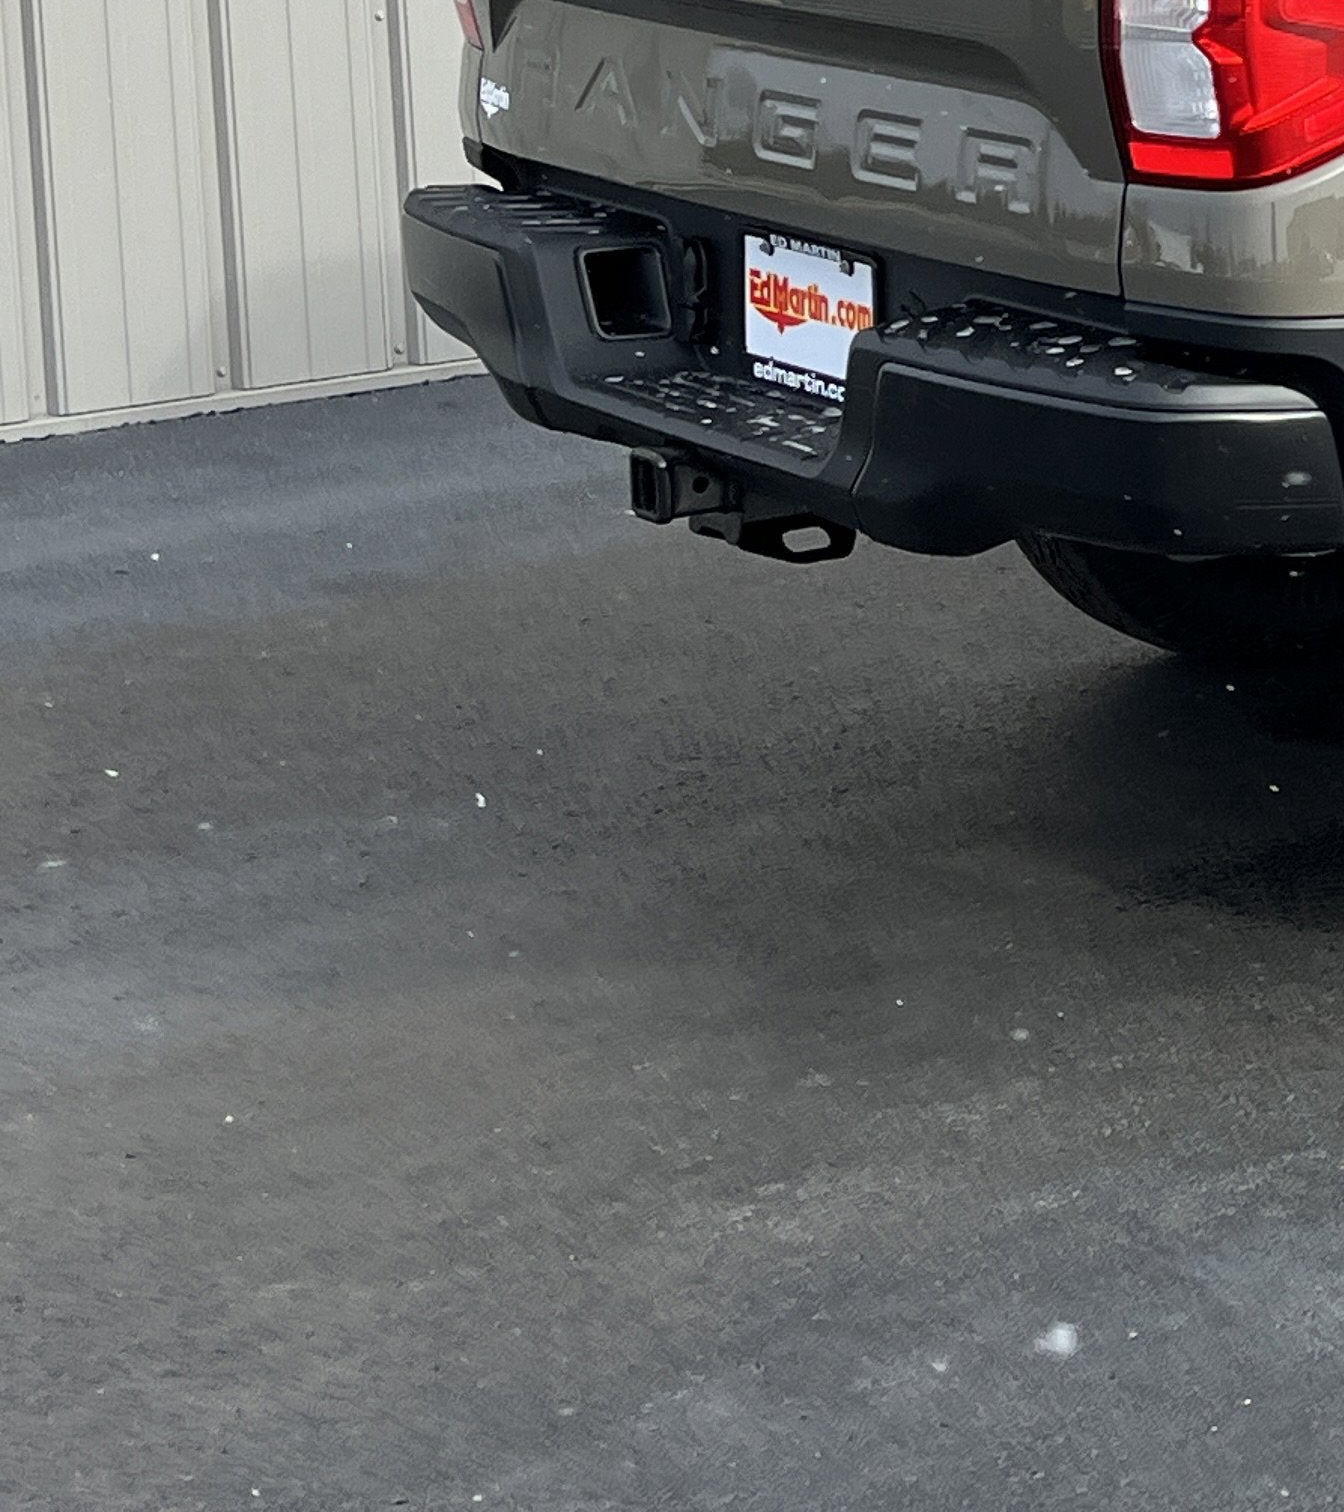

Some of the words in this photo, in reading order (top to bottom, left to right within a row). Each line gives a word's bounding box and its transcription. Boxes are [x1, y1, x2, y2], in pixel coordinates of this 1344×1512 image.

[769, 233, 788, 249] ED
[790, 239, 841, 262] MARTIN
[749, 268, 872, 331] EdMartin.com
